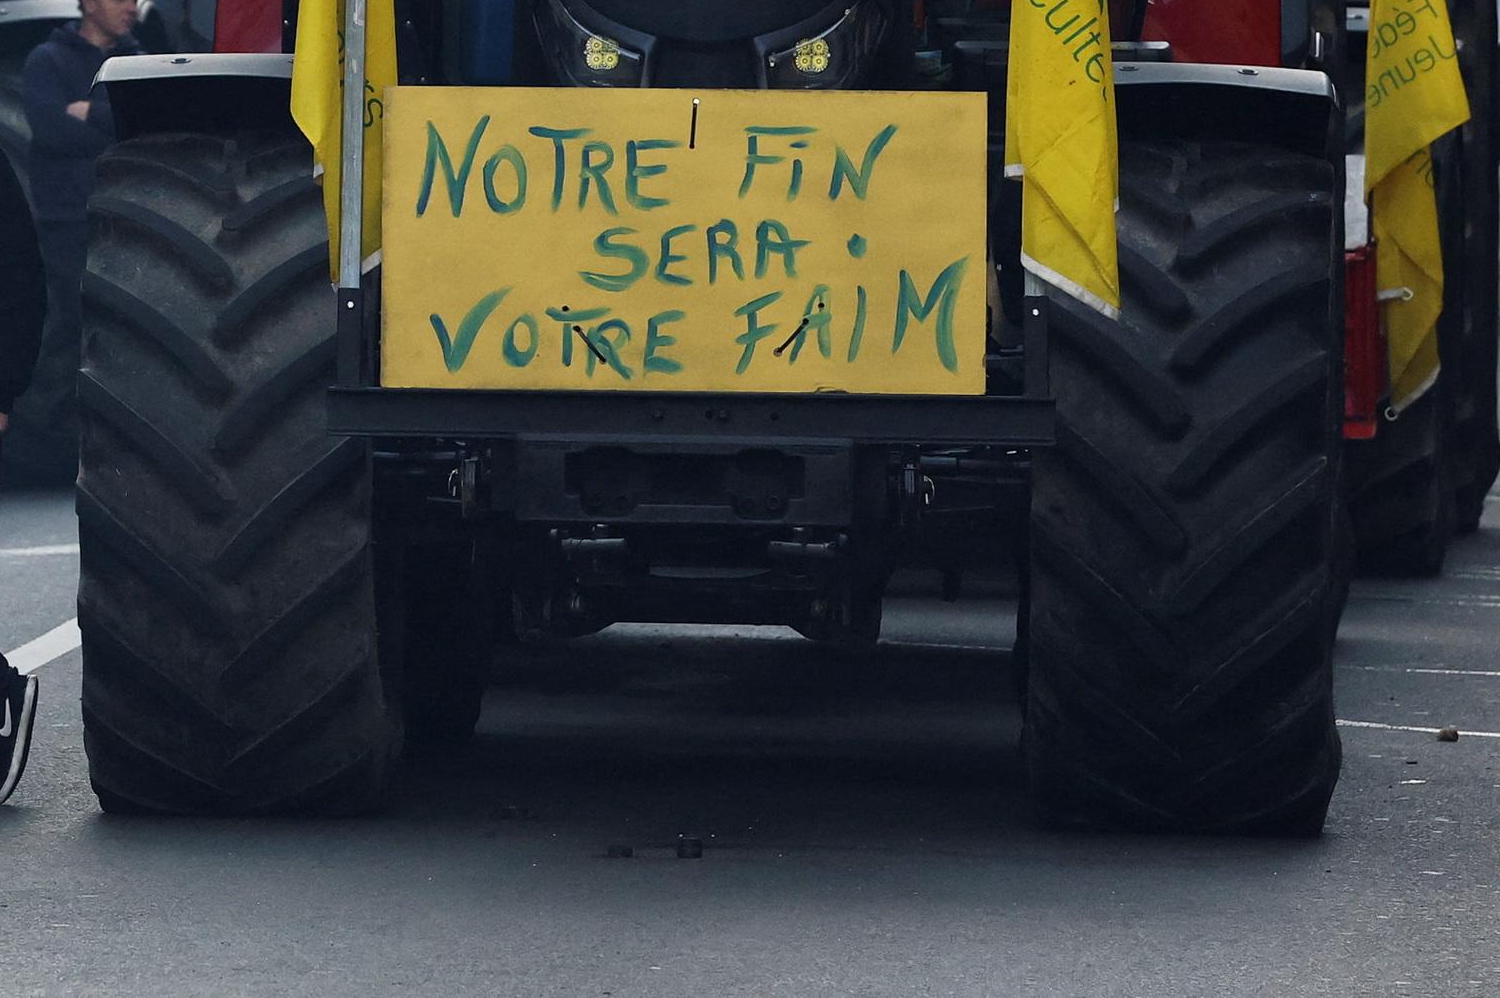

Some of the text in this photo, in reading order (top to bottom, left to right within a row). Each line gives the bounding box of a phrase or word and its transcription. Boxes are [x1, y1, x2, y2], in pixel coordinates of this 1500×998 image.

[416, 114, 686, 218] NOTRE
[578, 218, 812, 292] SERA
[430, 238, 969, 380] VOTRE FAIM
